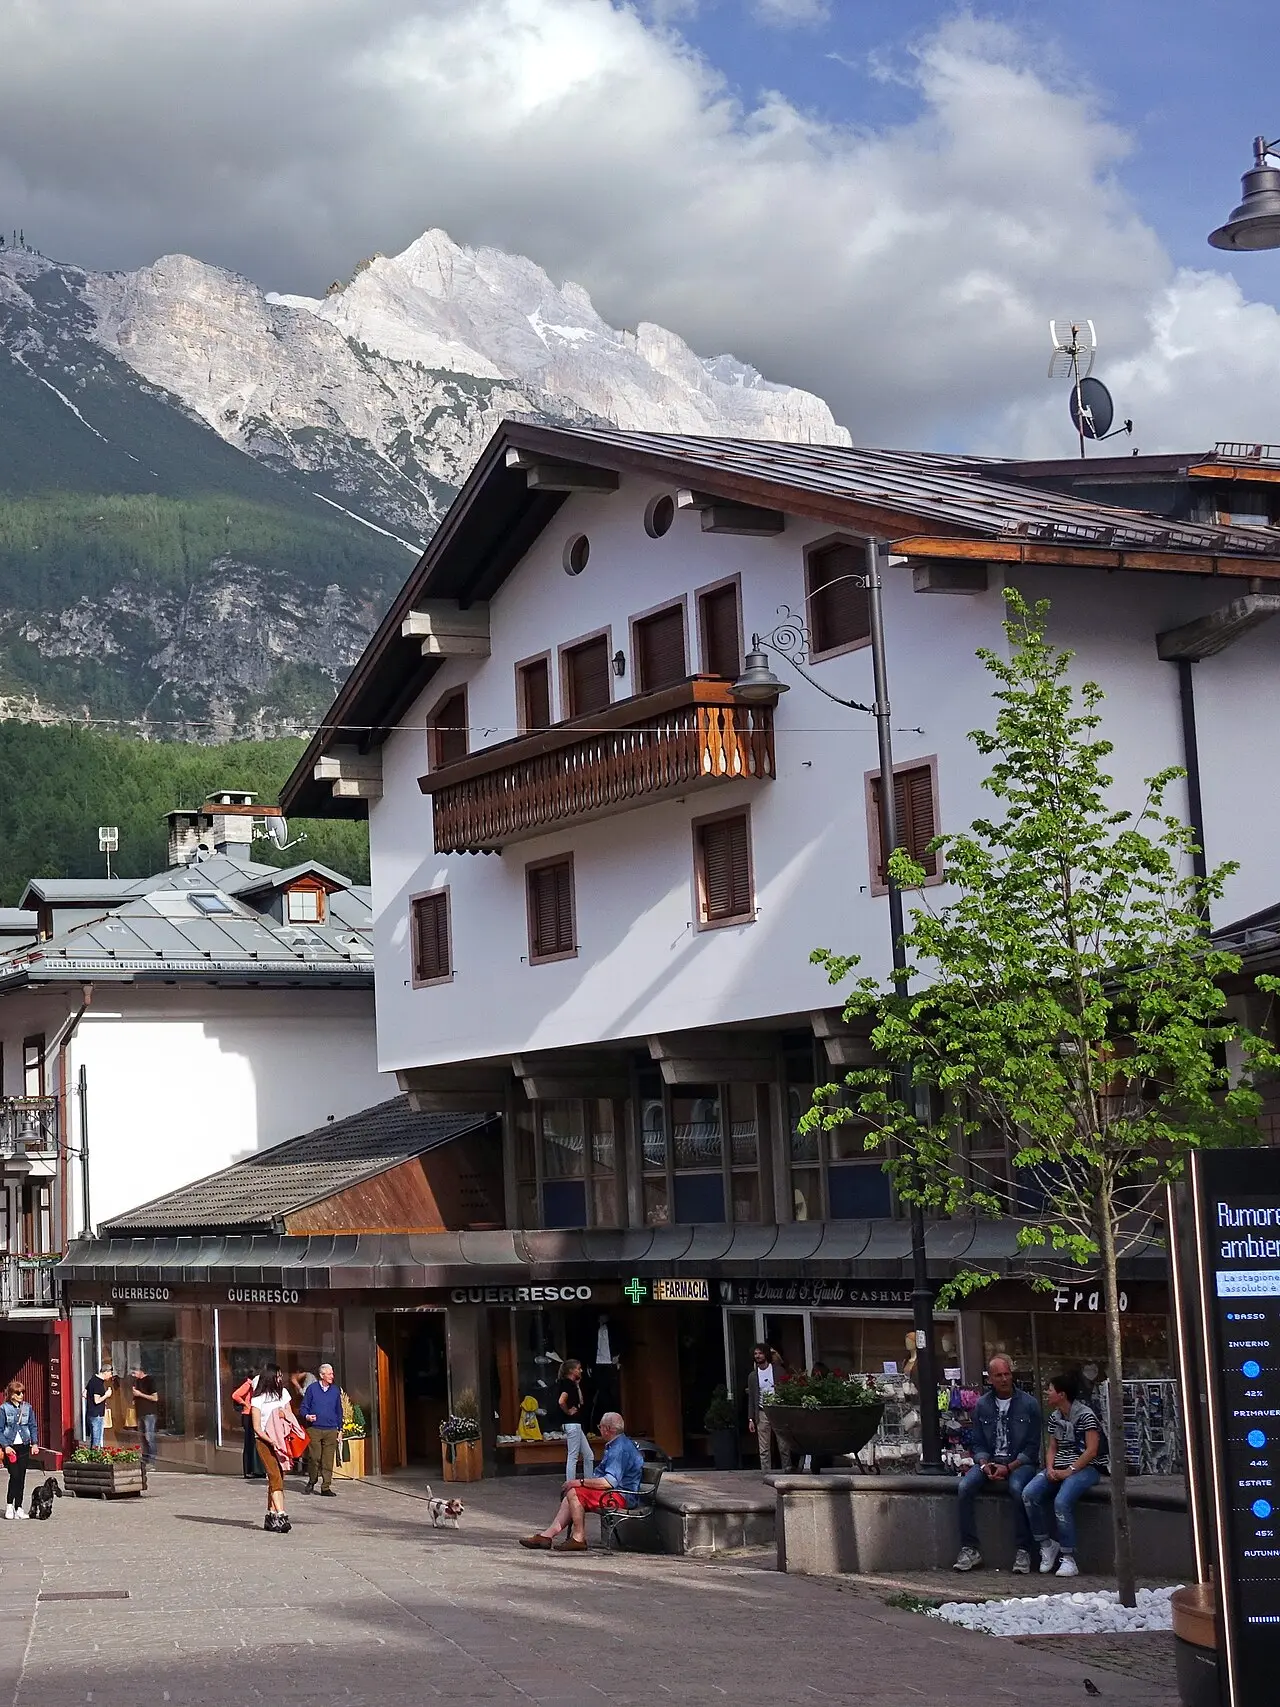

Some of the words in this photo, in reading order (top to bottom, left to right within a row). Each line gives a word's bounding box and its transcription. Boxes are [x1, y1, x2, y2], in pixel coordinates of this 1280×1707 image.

[1217, 1202, 1280, 1227] Rumore
[1224, 1274, 1235, 1282] La
[1238, 1274, 1280, 1284] stagione
[111, 1287, 169, 1300] GUERRESCO
[228, 1288, 299, 1304] GUERRESCO
[450, 1286, 592, 1304] GUERRESCO
[664, 1281, 709, 1299] FARMACIA
[754, 1279, 784, 1300] Duca
[785, 1280, 798, 1300] di
[811, 1279, 844, 1306] Giusto
[849, 1290, 912, 1302] CASHME
[1225, 1285, 1268, 1293] assoluto
[1053, 1286, 1128, 1312] Frao
[1228, 1340, 1270, 1348] INVERNO
[1238, 1479, 1272, 1487] ESTATE
